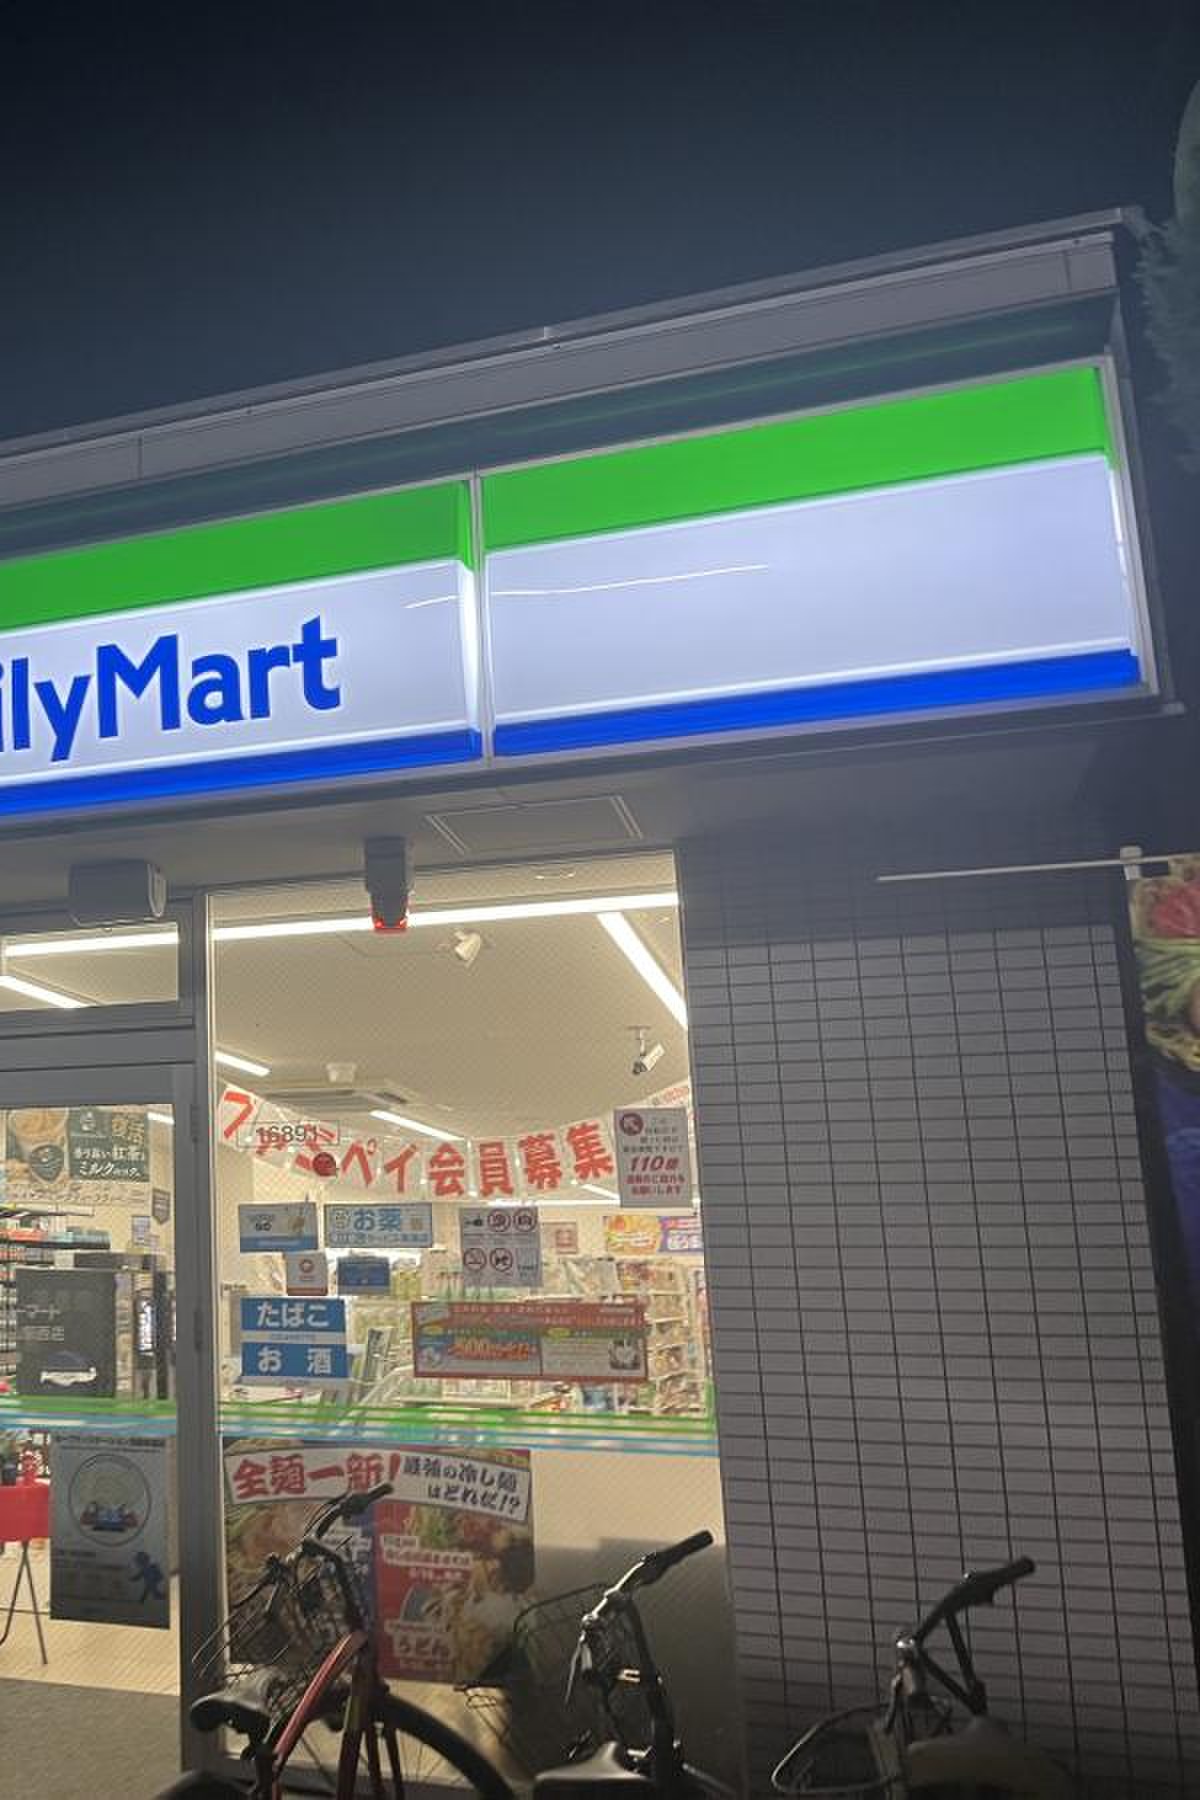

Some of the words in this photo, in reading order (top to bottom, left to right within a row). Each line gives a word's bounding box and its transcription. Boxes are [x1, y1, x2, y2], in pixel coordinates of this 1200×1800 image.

[257, 1302, 329, 1327] たばこ
[258, 1346, 332, 1374] お酒
